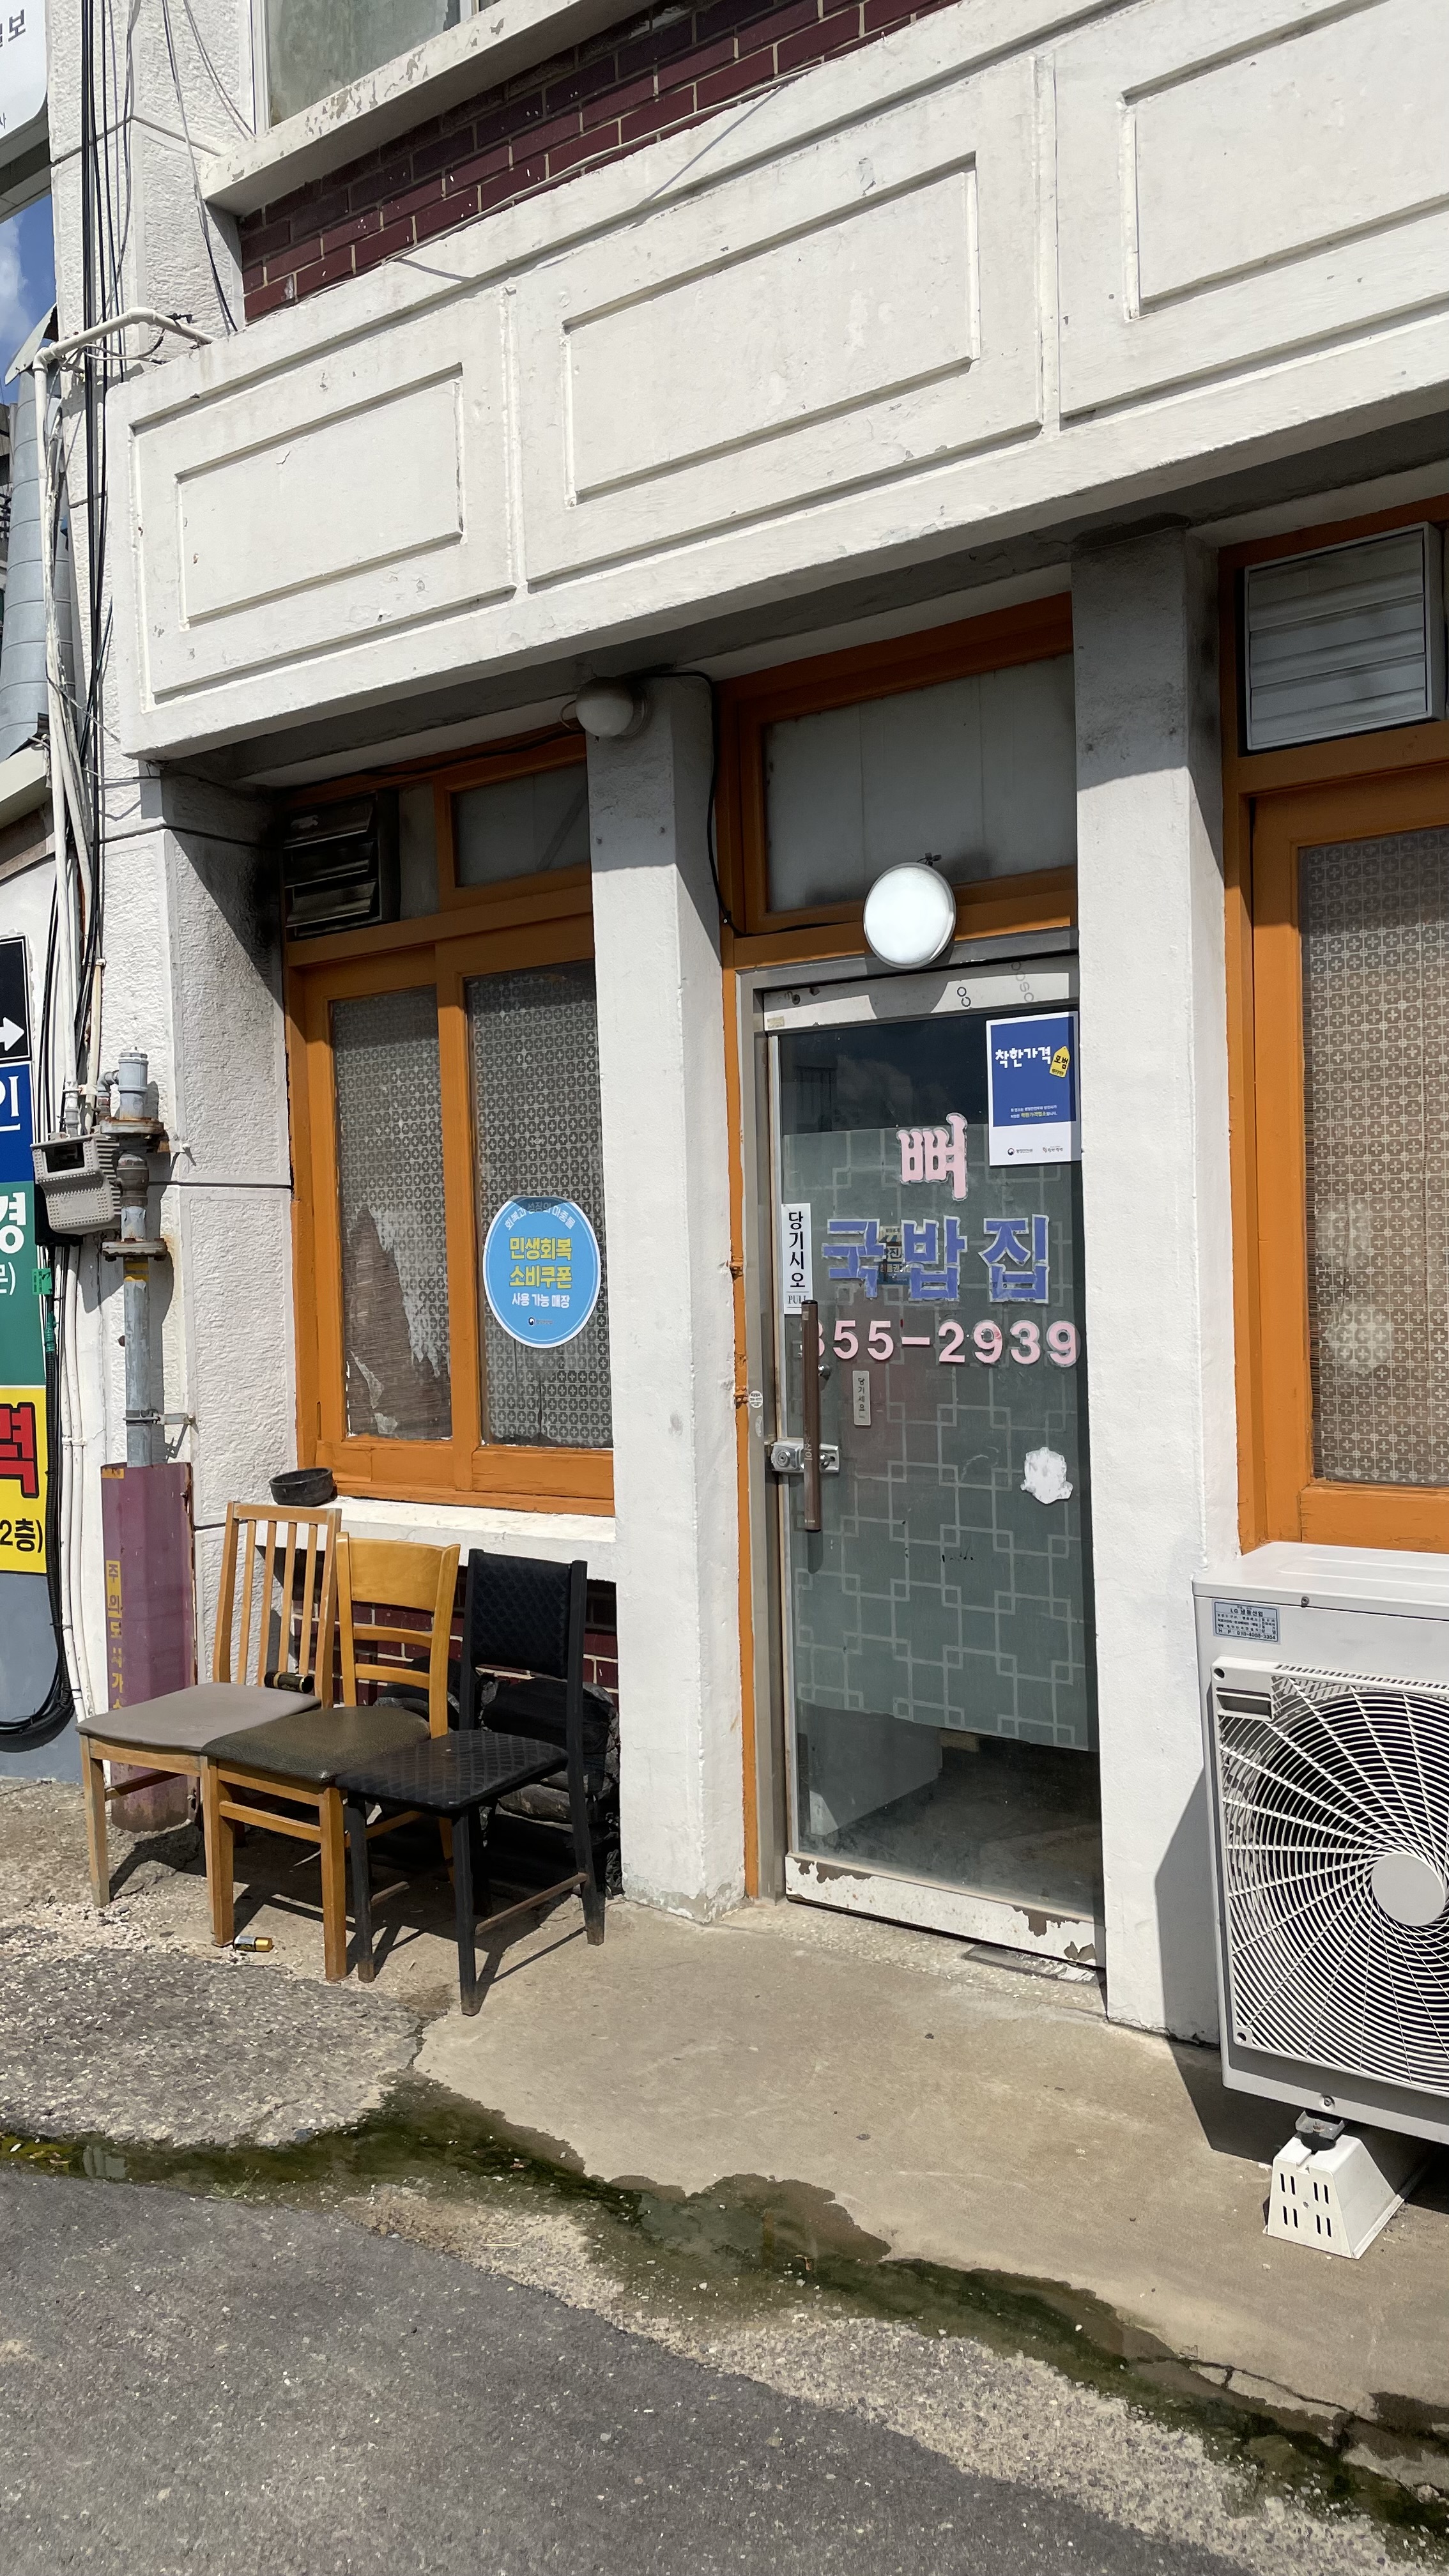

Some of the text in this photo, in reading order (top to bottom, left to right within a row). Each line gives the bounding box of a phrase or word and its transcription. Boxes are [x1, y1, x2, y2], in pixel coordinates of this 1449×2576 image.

[0, 9, 26, 47] 보
[995, 1046, 1051, 1069] 착한가격
[896, 1112, 968, 1200] 뼈
[509, 1237, 572, 1261] 민생회복
[788, 1211, 806, 1288] 당기시오
[509, 1265, 572, 1289] 소비쿠폰
[512, 1292, 571, 1308] 사용 가능 매장
